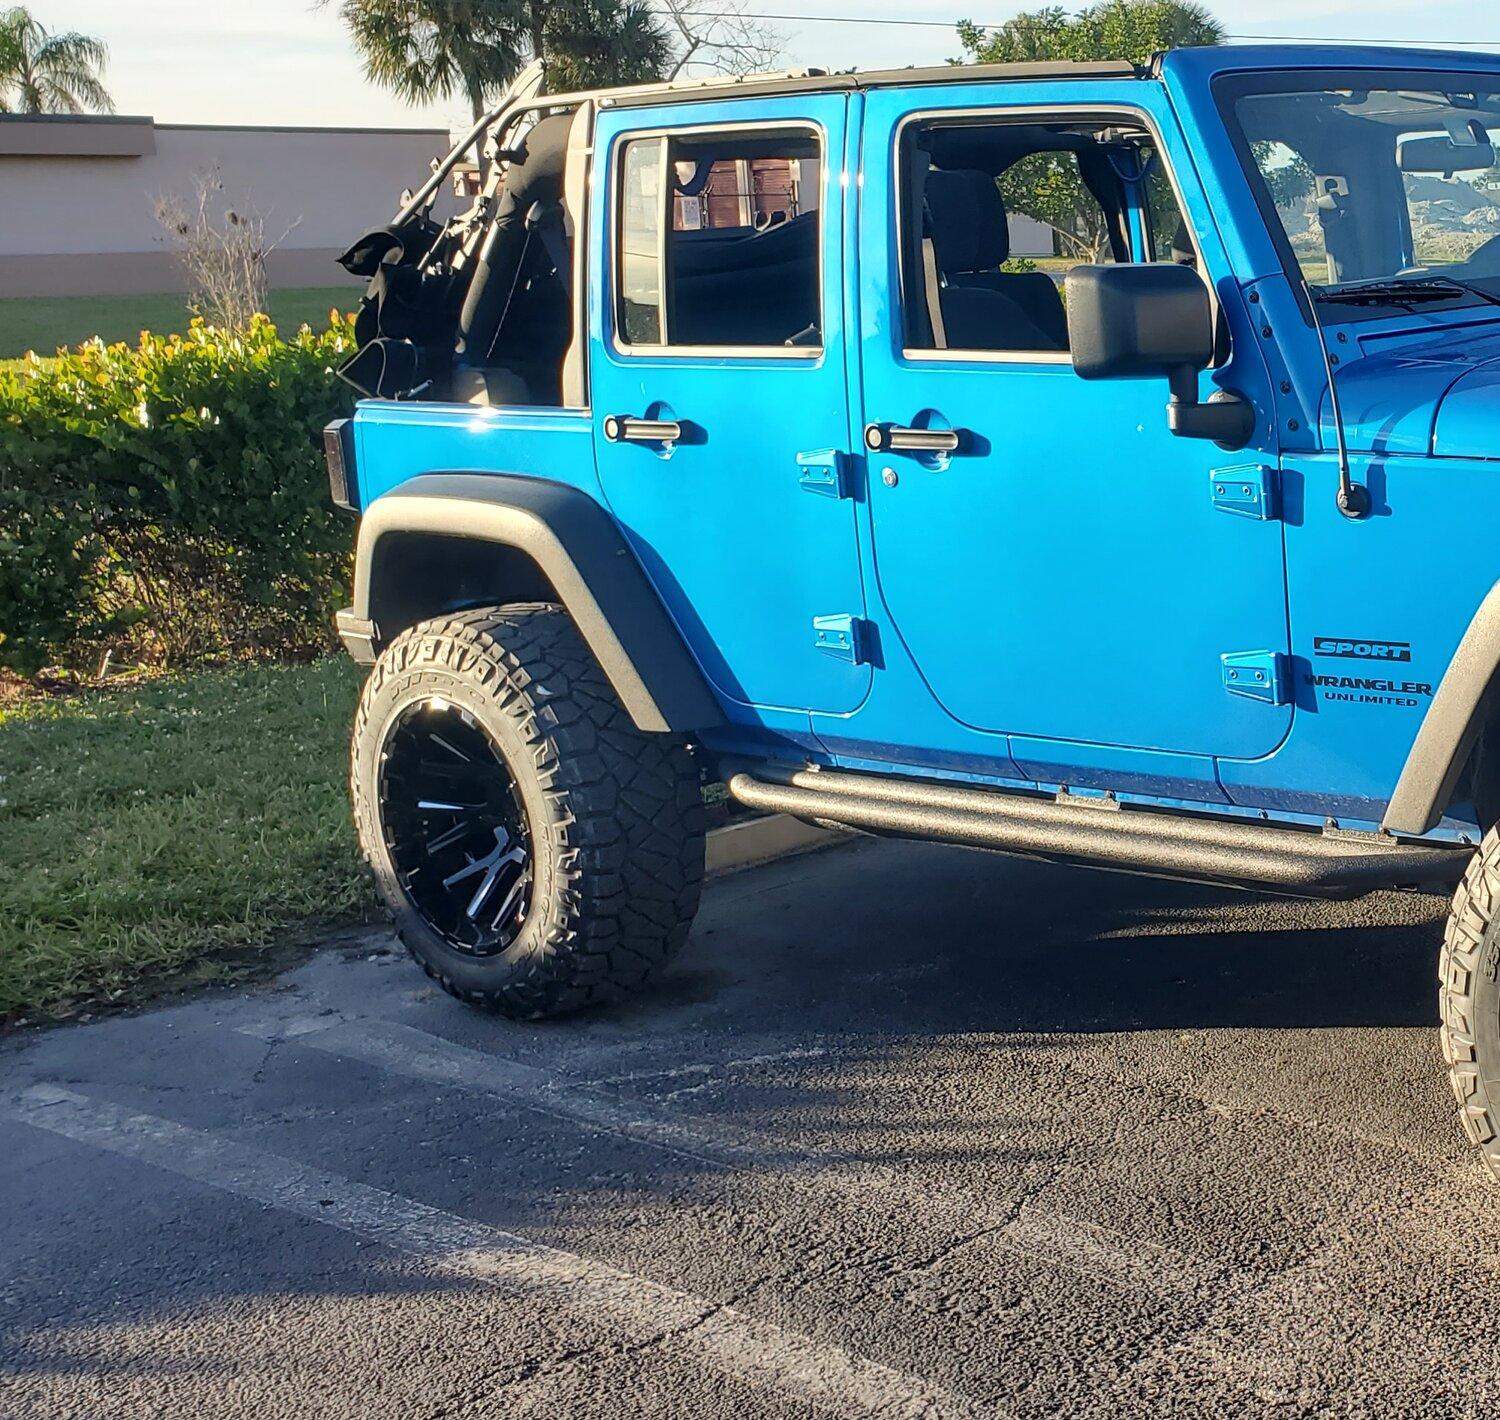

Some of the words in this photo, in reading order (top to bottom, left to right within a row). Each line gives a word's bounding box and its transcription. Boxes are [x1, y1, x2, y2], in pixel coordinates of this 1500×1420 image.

[1319, 641, 1409, 658] SPORT
[1305, 674, 1434, 696] WRANGLER
[1324, 692, 1418, 707] UNLIMITED
